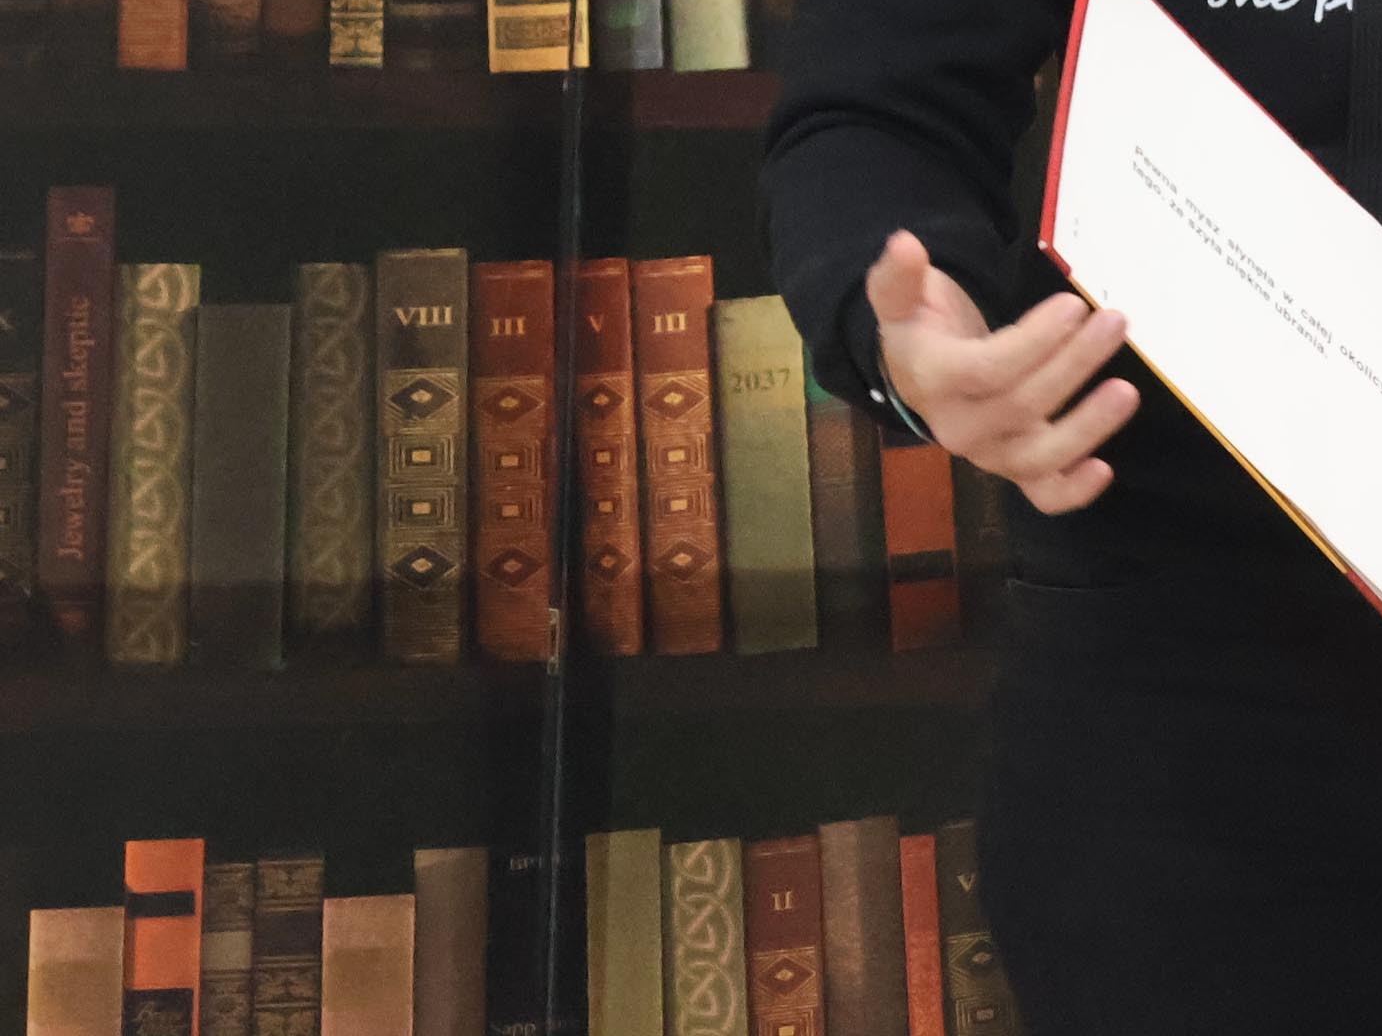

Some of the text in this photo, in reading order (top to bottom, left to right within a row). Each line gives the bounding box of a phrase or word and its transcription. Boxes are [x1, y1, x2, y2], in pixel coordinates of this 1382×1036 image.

[1282, 290, 1295, 305] w
[394, 306, 453, 327] VIII
[491, 317, 526, 336] III
